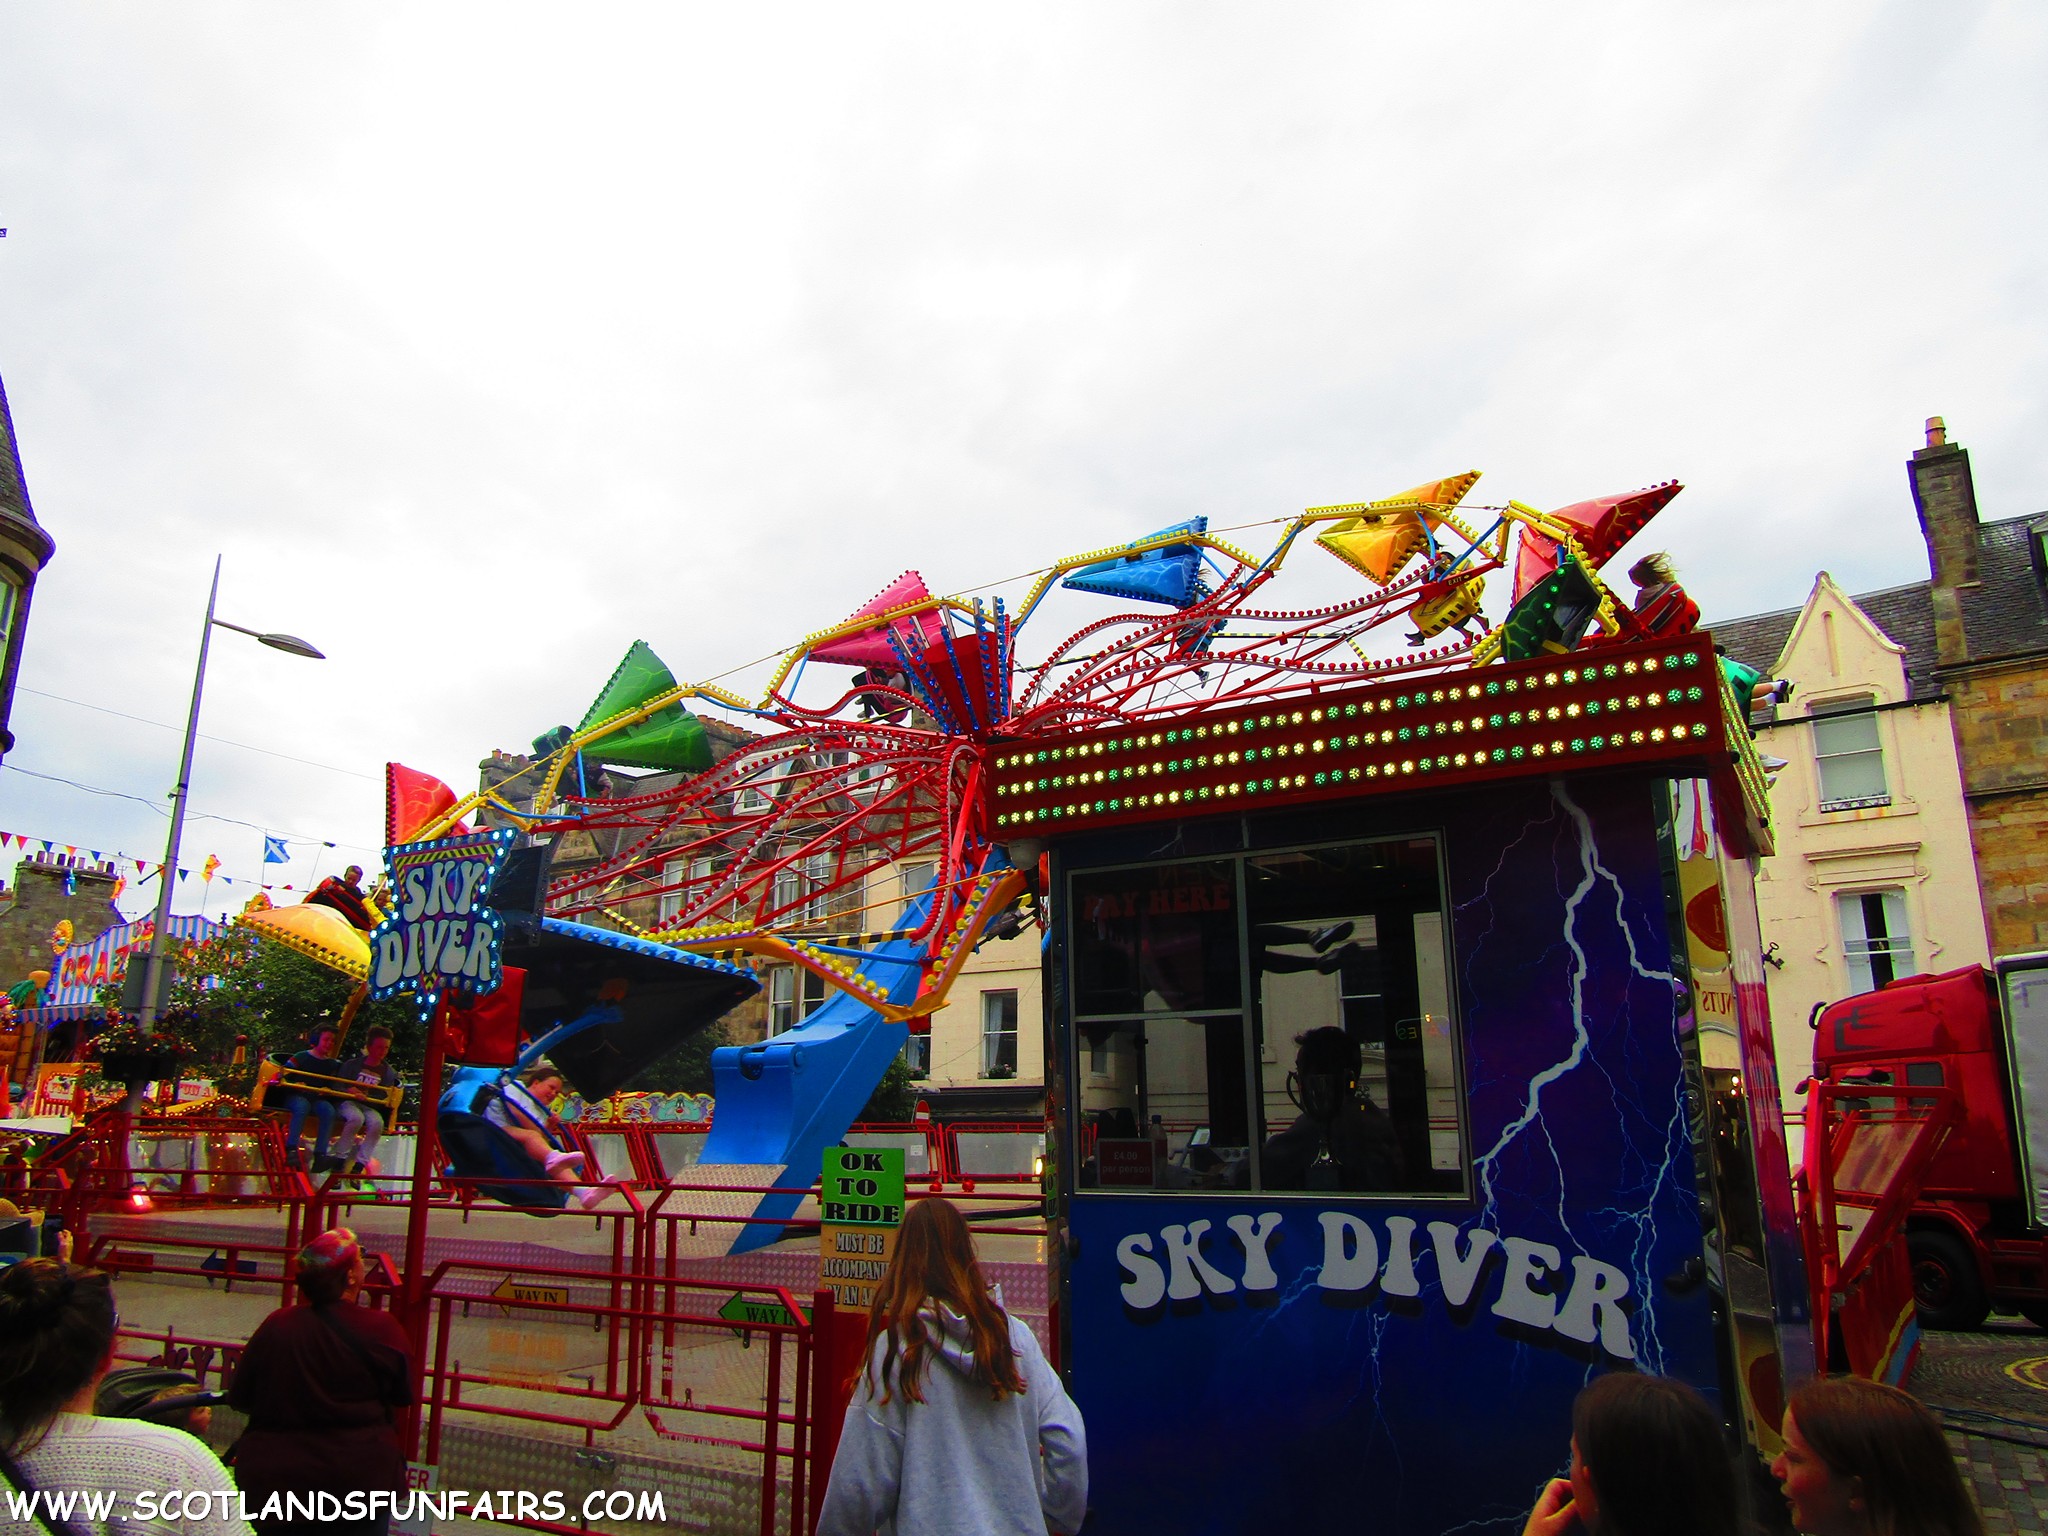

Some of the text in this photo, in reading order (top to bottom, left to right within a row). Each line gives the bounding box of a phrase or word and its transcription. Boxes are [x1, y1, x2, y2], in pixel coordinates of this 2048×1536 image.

[1447, 576, 1462, 586] EXIT
[403, 860, 485, 922] SKY
[1083, 883, 1231, 922] PAY HERE
[375, 919, 494, 988] DIVER
[840, 1152, 885, 1171] OK
[836, 1177, 878, 1196] TO
[824, 1201, 900, 1222] RIDE
[836, 1231, 885, 1255] MUST BE
[514, 1288, 559, 1304] WAY IN
[843, 1285, 859, 1306] AN
[1116, 1211, 1636, 1360] SKY DIVER
[745, 1306, 781, 1324] WAY
